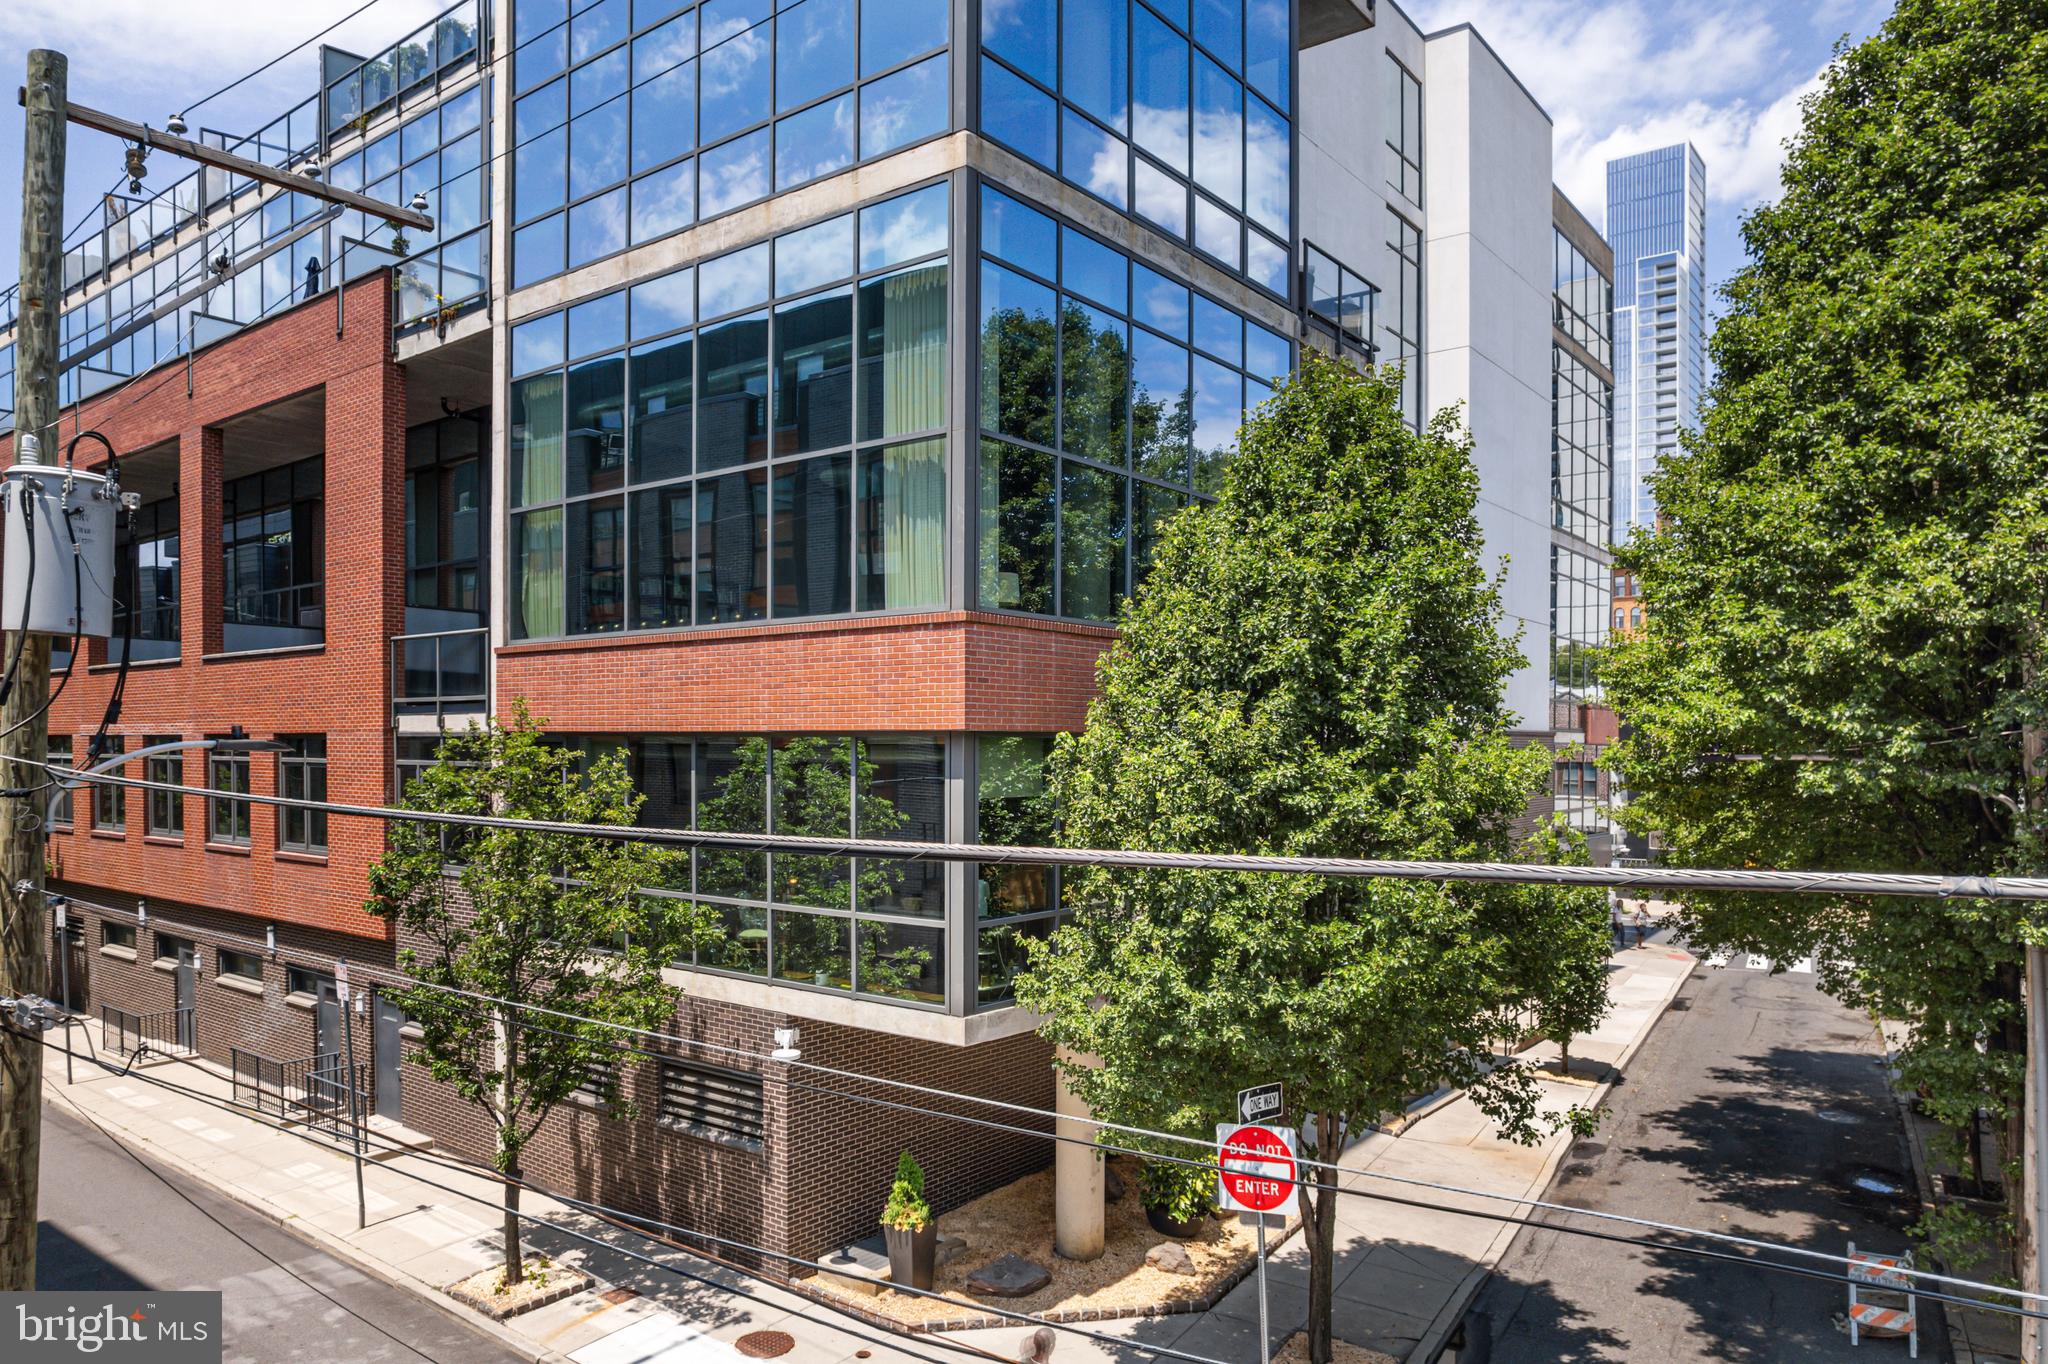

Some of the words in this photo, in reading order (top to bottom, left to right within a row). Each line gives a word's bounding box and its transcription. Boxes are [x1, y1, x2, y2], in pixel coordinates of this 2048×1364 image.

[1250, 1097, 1261, 1112] ONE
[1263, 1093, 1278, 1109] WAY
[1229, 1142, 1248, 1156] DO
[1256, 1144, 1283, 1158] NOT
[1235, 1179, 1280, 1197] ENTER
